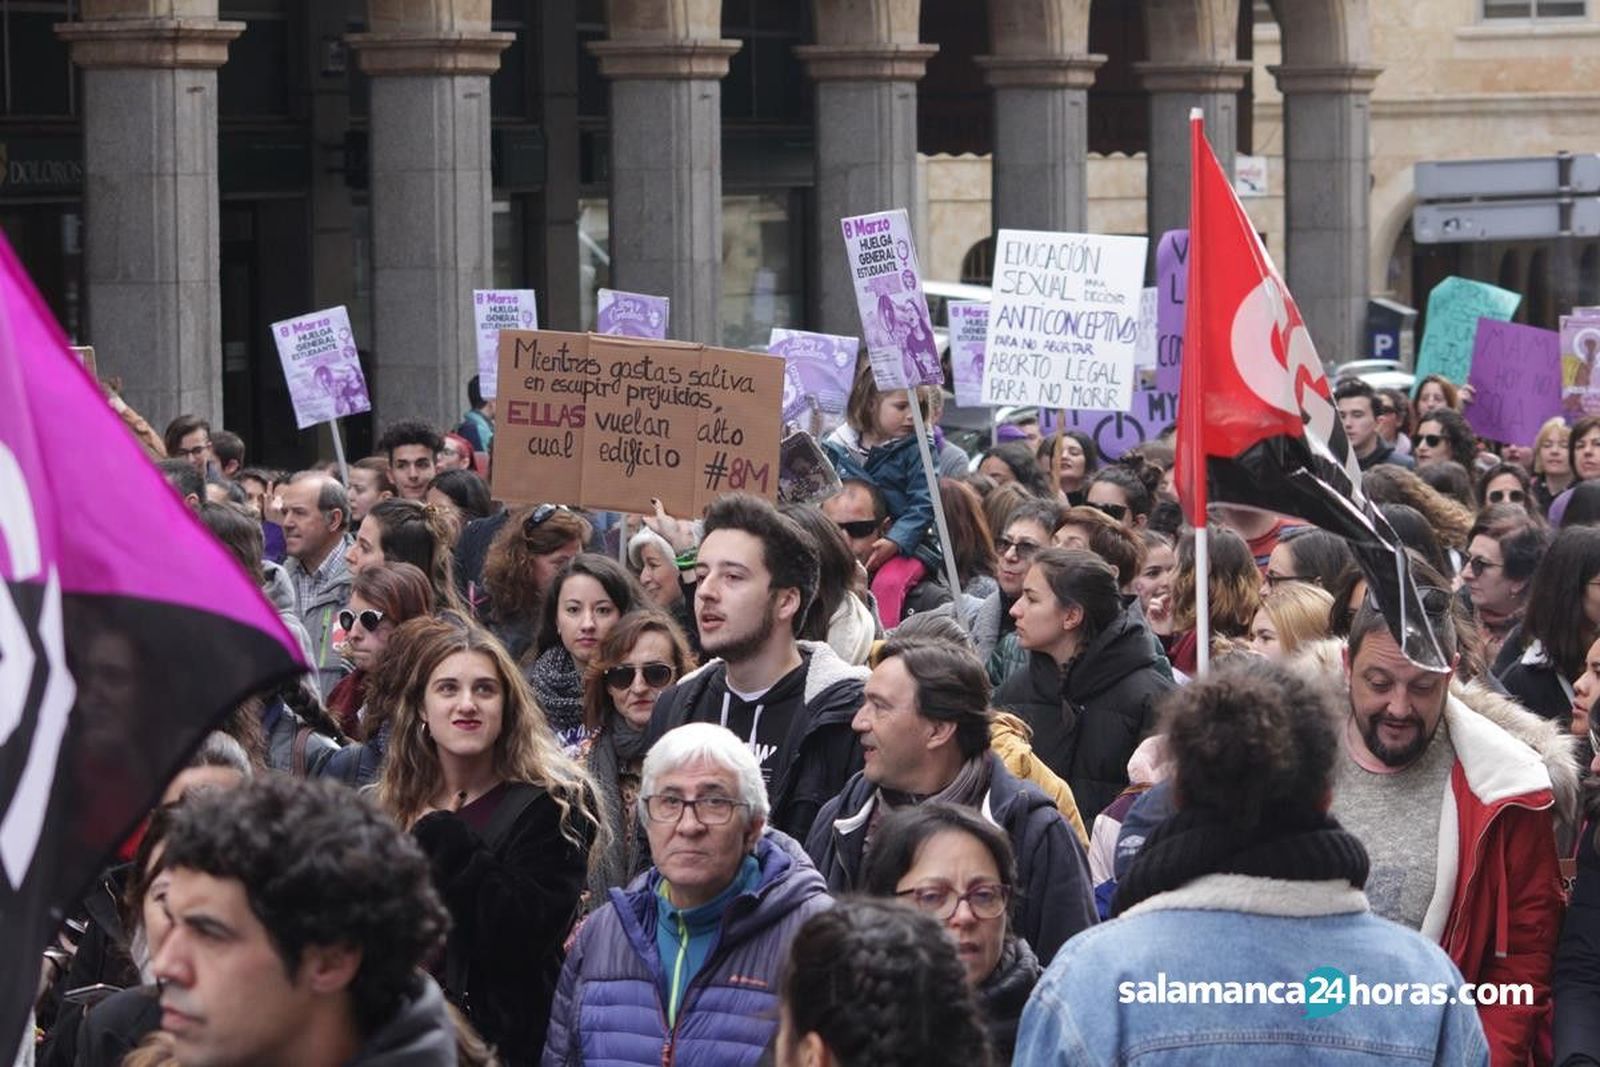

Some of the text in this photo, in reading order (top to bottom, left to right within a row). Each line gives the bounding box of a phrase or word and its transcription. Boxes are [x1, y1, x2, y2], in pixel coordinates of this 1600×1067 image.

[843, 219, 890, 238] 8 Marzo
[859, 234, 893, 251] HUELGA
[858, 248, 895, 265] GENERAL
[1004, 238, 1101, 275] EDUCACIÓN
[857, 262, 898, 278] ESTUDIANTIL
[1000, 270, 1076, 302] SEXUAL
[280, 318, 330, 337] 8 Marzo
[297, 327, 333, 342] HUELGA
[295, 336, 336, 352] GENERAL
[995, 335, 1095, 355] PARA NO ABORTAR
[1375, 334, 1393, 356] P
[514, 337, 755, 395] Mientras gastas saliva
[989, 352, 1121, 385] ABORTO LEGAL
[524, 376, 545, 392] en
[550, 377, 611, 404] escupir
[991, 378, 1120, 408] PARA NO MORIR
[507, 400, 744, 446] ELLAS vuelan alto
[528, 430, 680, 478] cual edificio
[704, 451, 770, 494] #8M
